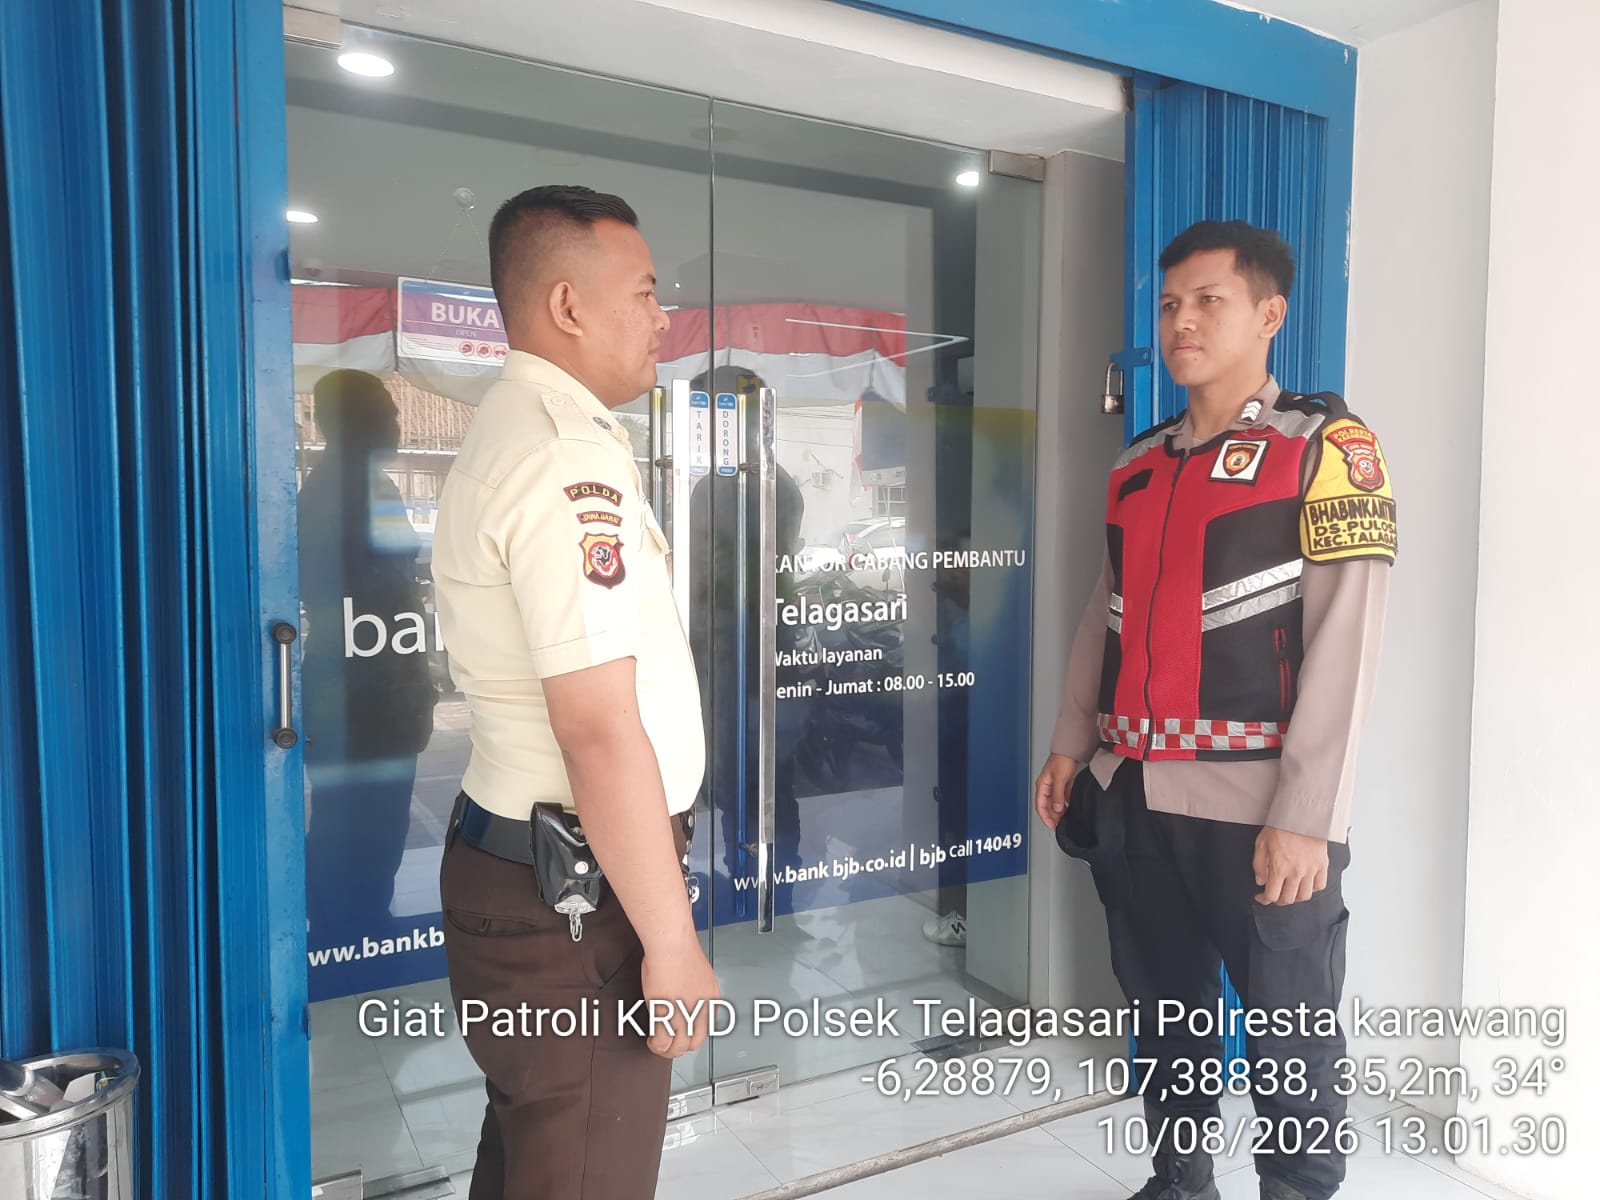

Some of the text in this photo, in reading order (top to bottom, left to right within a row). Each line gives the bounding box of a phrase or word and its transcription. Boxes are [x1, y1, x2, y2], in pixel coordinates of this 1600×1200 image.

[431, 302, 500, 329] BUKA
[456, 328, 478, 338] OPEN
[695, 410, 703, 465] TARIK
[722, 410, 730, 466] DORONG
[569, 485, 619, 503] POLDA
[776, 550, 1026, 574] ANOR CABANG PEMBANTU
[822, 647, 883, 667] layanan
[776, 681, 812, 699] enin
[825, 679, 873, 696] Jumat
[884, 676, 925, 692] 08.00
[937, 672, 975, 688] 15.00
[919, 843, 947, 869] bjb
[949, 840, 973, 858] call
[975, 833, 1022, 855] 14049
[308, 926, 445, 967] ww.bankb
